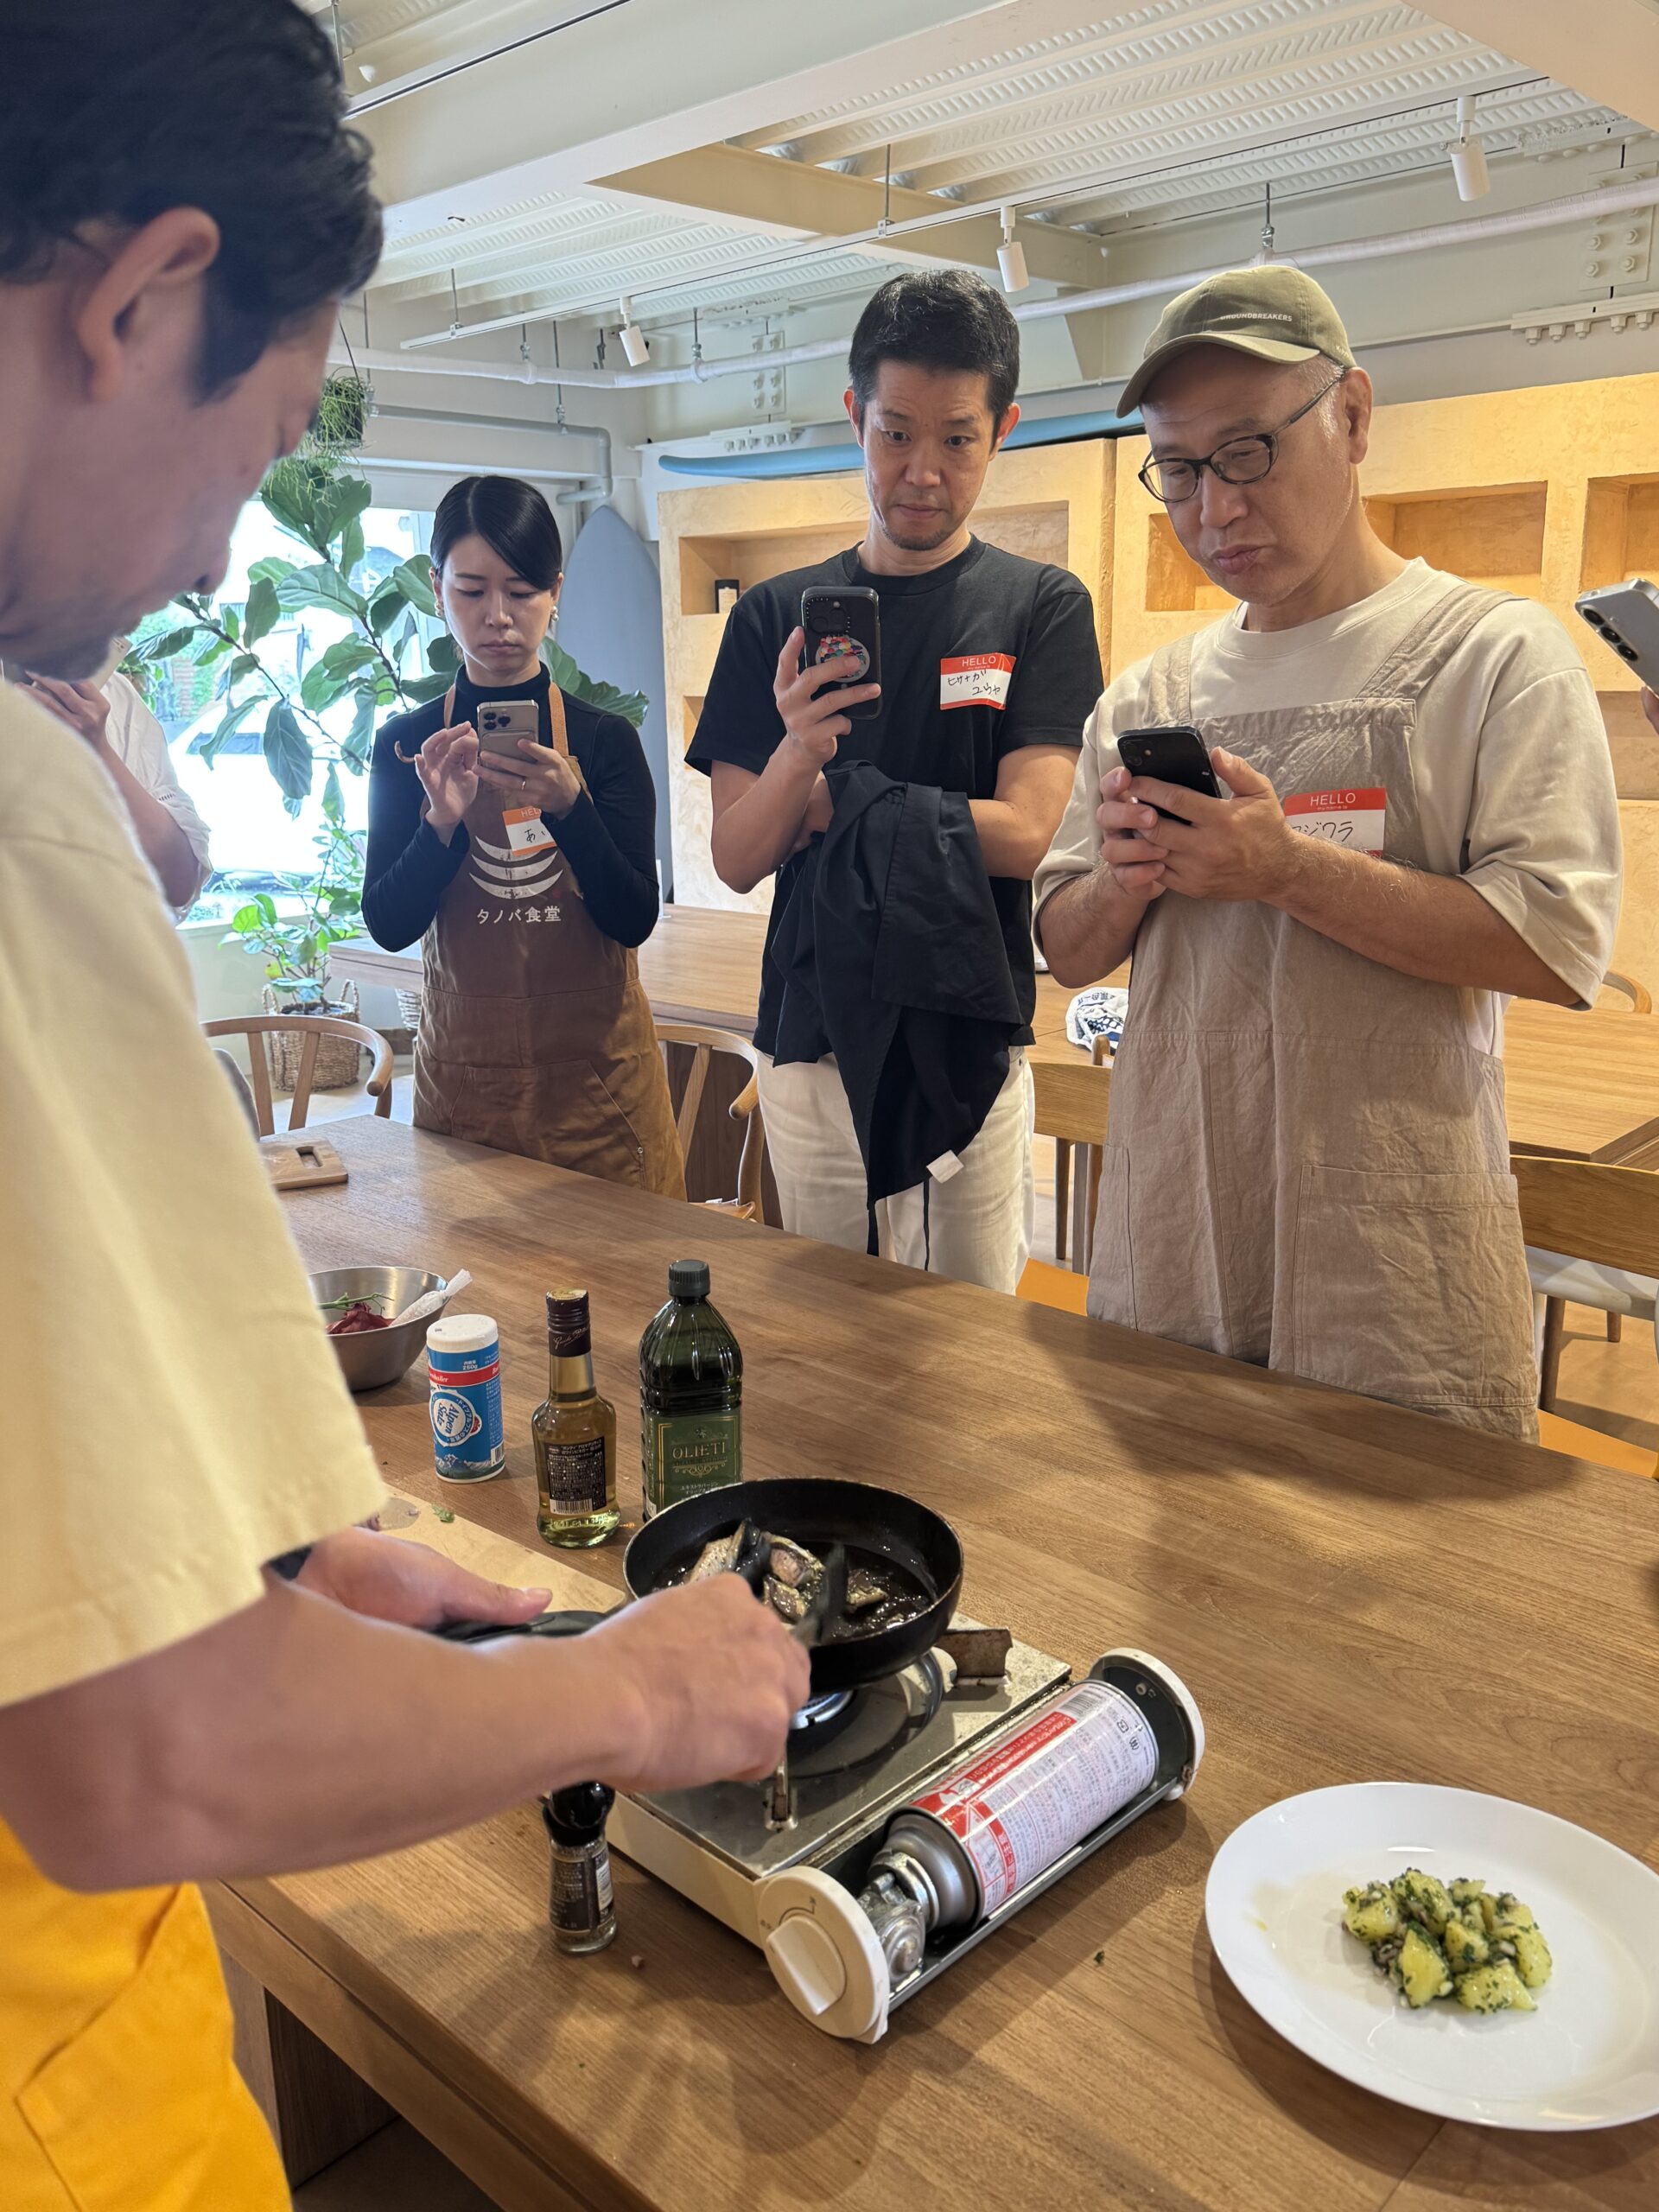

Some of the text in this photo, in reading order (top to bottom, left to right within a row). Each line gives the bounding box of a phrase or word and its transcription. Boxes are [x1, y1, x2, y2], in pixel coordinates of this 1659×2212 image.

[962, 656, 996, 667] HELLO
[1310, 792, 1357, 807] HELLO
[521, 808, 540, 817] HEL
[477, 906, 562, 925] タノバ食堂
[437, 1402, 448, 1427] Salz
[445, 1403, 460, 1434] Alpen
[672, 1441, 726, 1459] OLIETI
